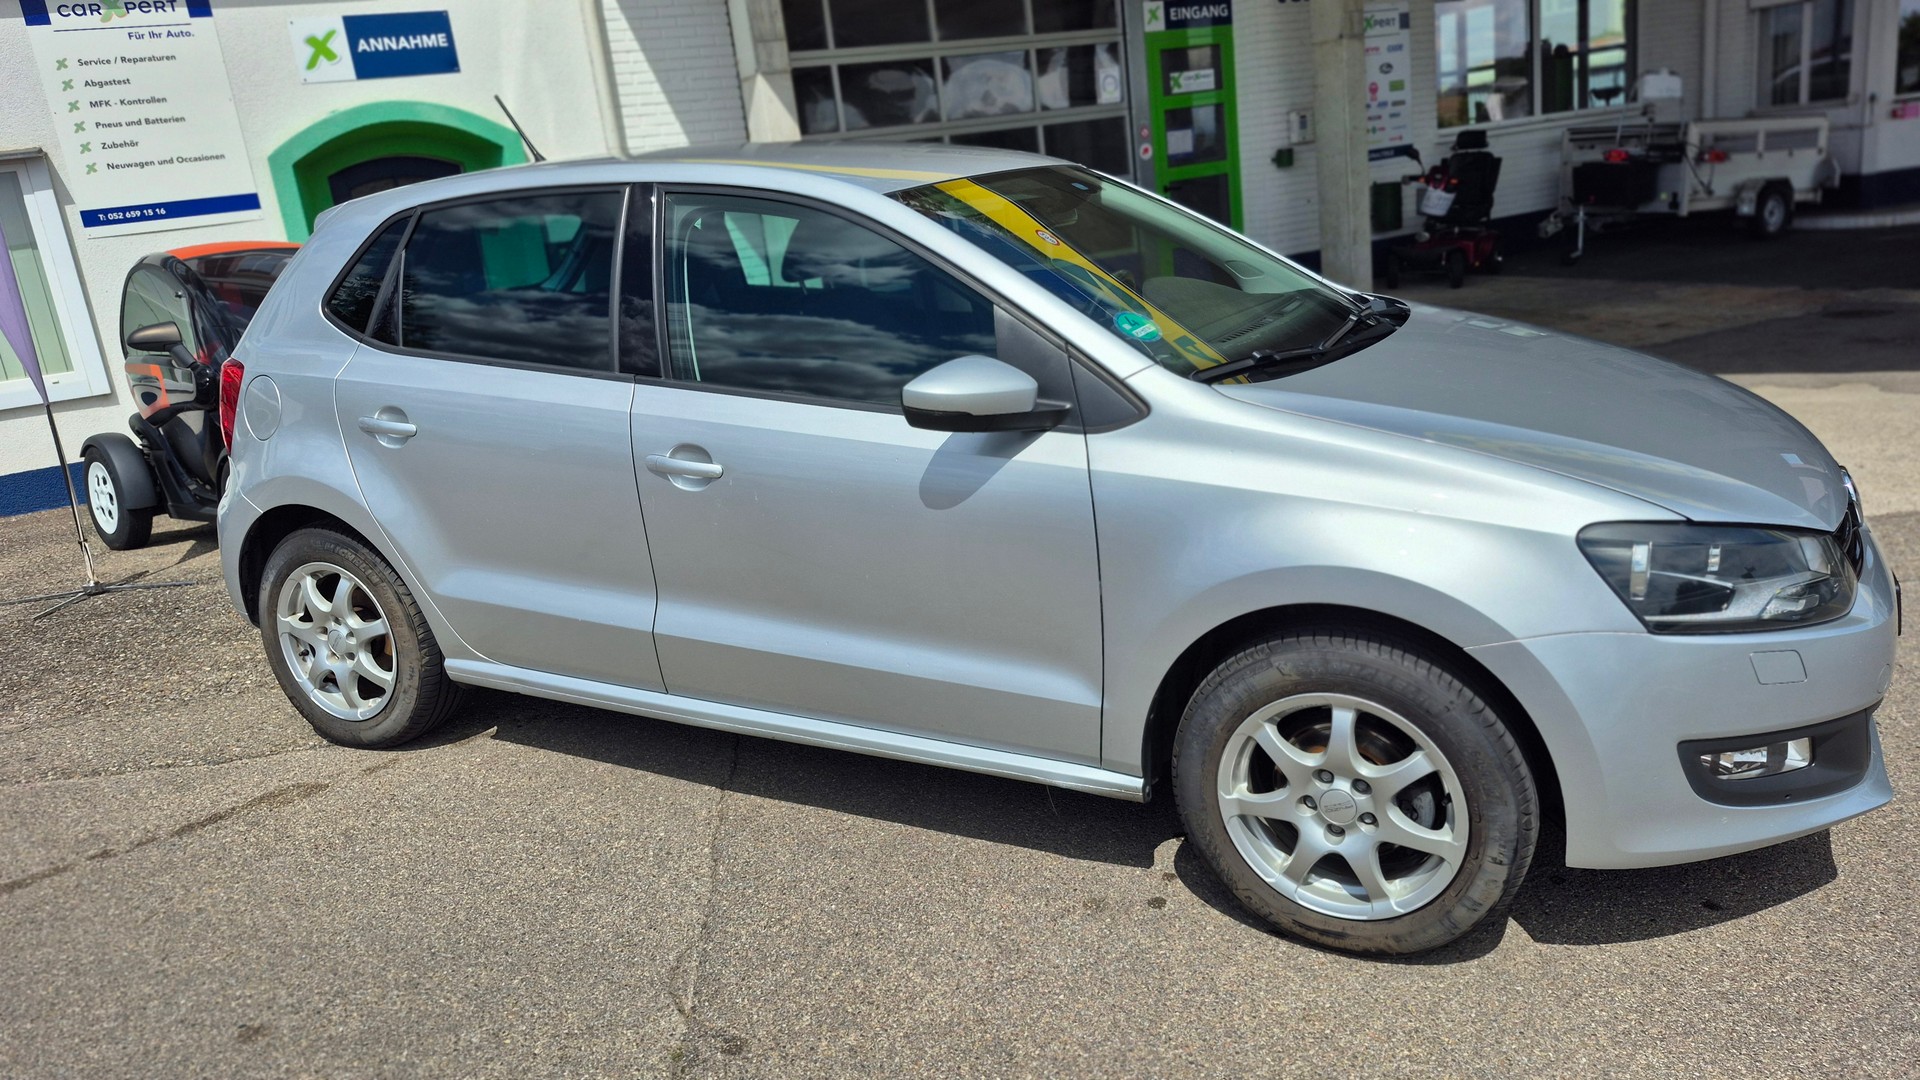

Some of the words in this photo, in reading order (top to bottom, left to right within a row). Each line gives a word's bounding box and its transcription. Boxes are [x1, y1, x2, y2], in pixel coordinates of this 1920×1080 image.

[1169, 4, 1229, 21] EINGANG
[127, 31, 145, 41] Für
[148, 30, 162, 39] Ihr
[166, 29, 195, 38] Auto.
[357, 33, 449, 53] ANNAHME
[77, 57, 112, 67] Service
[120, 54, 177, 65] Reparaturen
[84, 78, 131, 89] Abgastest
[89, 99, 112, 109] MFK
[119, 96, 168, 107] Kontrollen
[95, 121, 124, 130] Pneus
[125, 118, 143, 127] und
[144, 115, 187, 126] Batterien
[101, 140, 140, 150] Zubehör
[106, 160, 156, 170] Neuwagen
[157, 157, 175, 166] und
[176, 153, 226, 164] Occasionen
[98, 213, 107, 222] T:
[107, 211, 125, 221] 052
[125, 210, 141, 219] 659
[143, 208, 154, 217] 15
[155, 207, 167, 216] 16
[325, 541, 382, 587] MICHELIN
